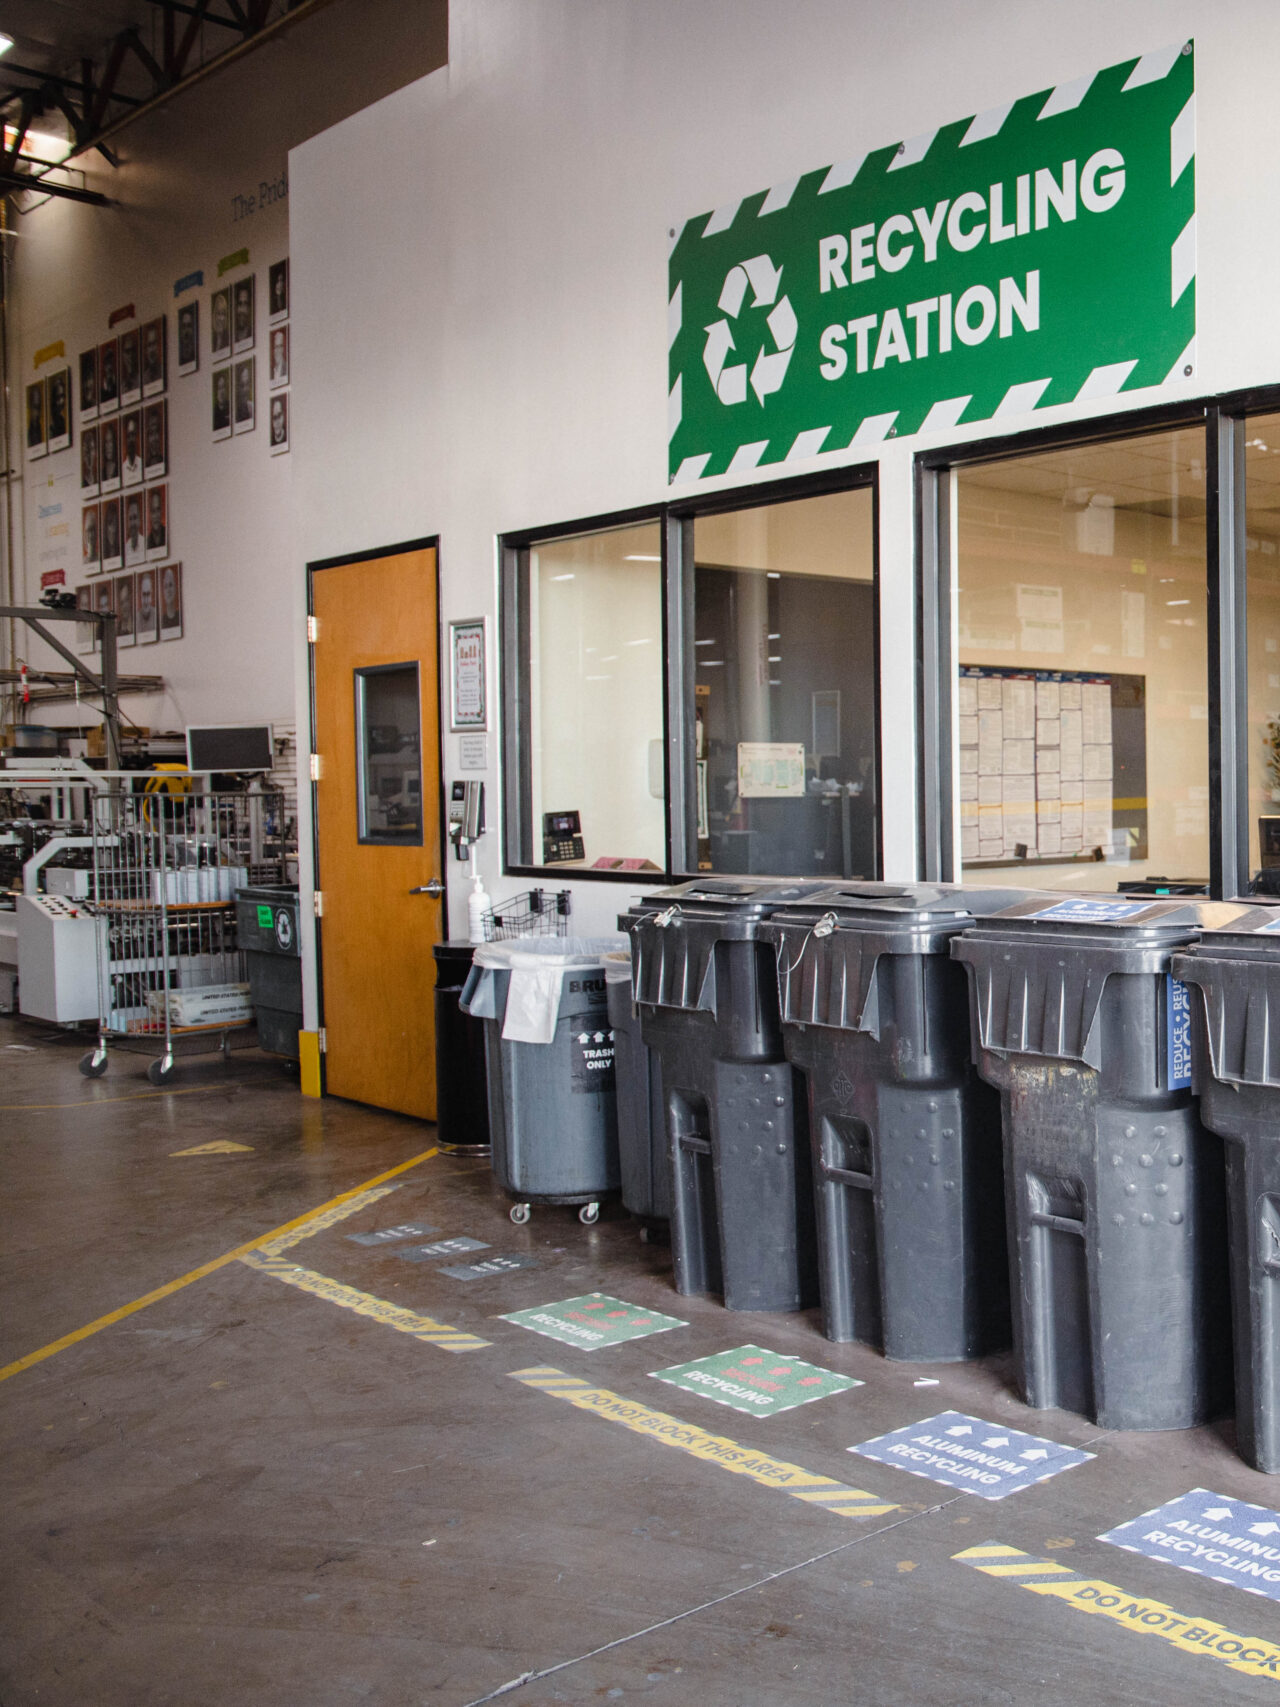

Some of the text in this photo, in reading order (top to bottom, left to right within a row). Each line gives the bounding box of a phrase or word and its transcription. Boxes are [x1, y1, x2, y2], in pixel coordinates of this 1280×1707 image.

[231, 171, 288, 221] The Prid
[819, 148, 1126, 294] RECYCLING
[819, 270, 1041, 381] STATION
[1172, 978, 1184, 1080] REDUCE REU
[583, 1048, 615, 1058] TRASH
[586, 1060, 612, 1070] ONLY
[529, 1313, 605, 1341] RECYCLING
[682, 1370, 774, 1405] RECYCLING
[582, 1393, 795, 1484] DO NOT BLOCK THIS AREA
[910, 1435, 1028, 1475] ALUMINUM
[886, 1443, 1002, 1485] RECYCLING
[1073, 1586, 1121, 1610] DO
[1117, 1599, 1190, 1632] NOT
